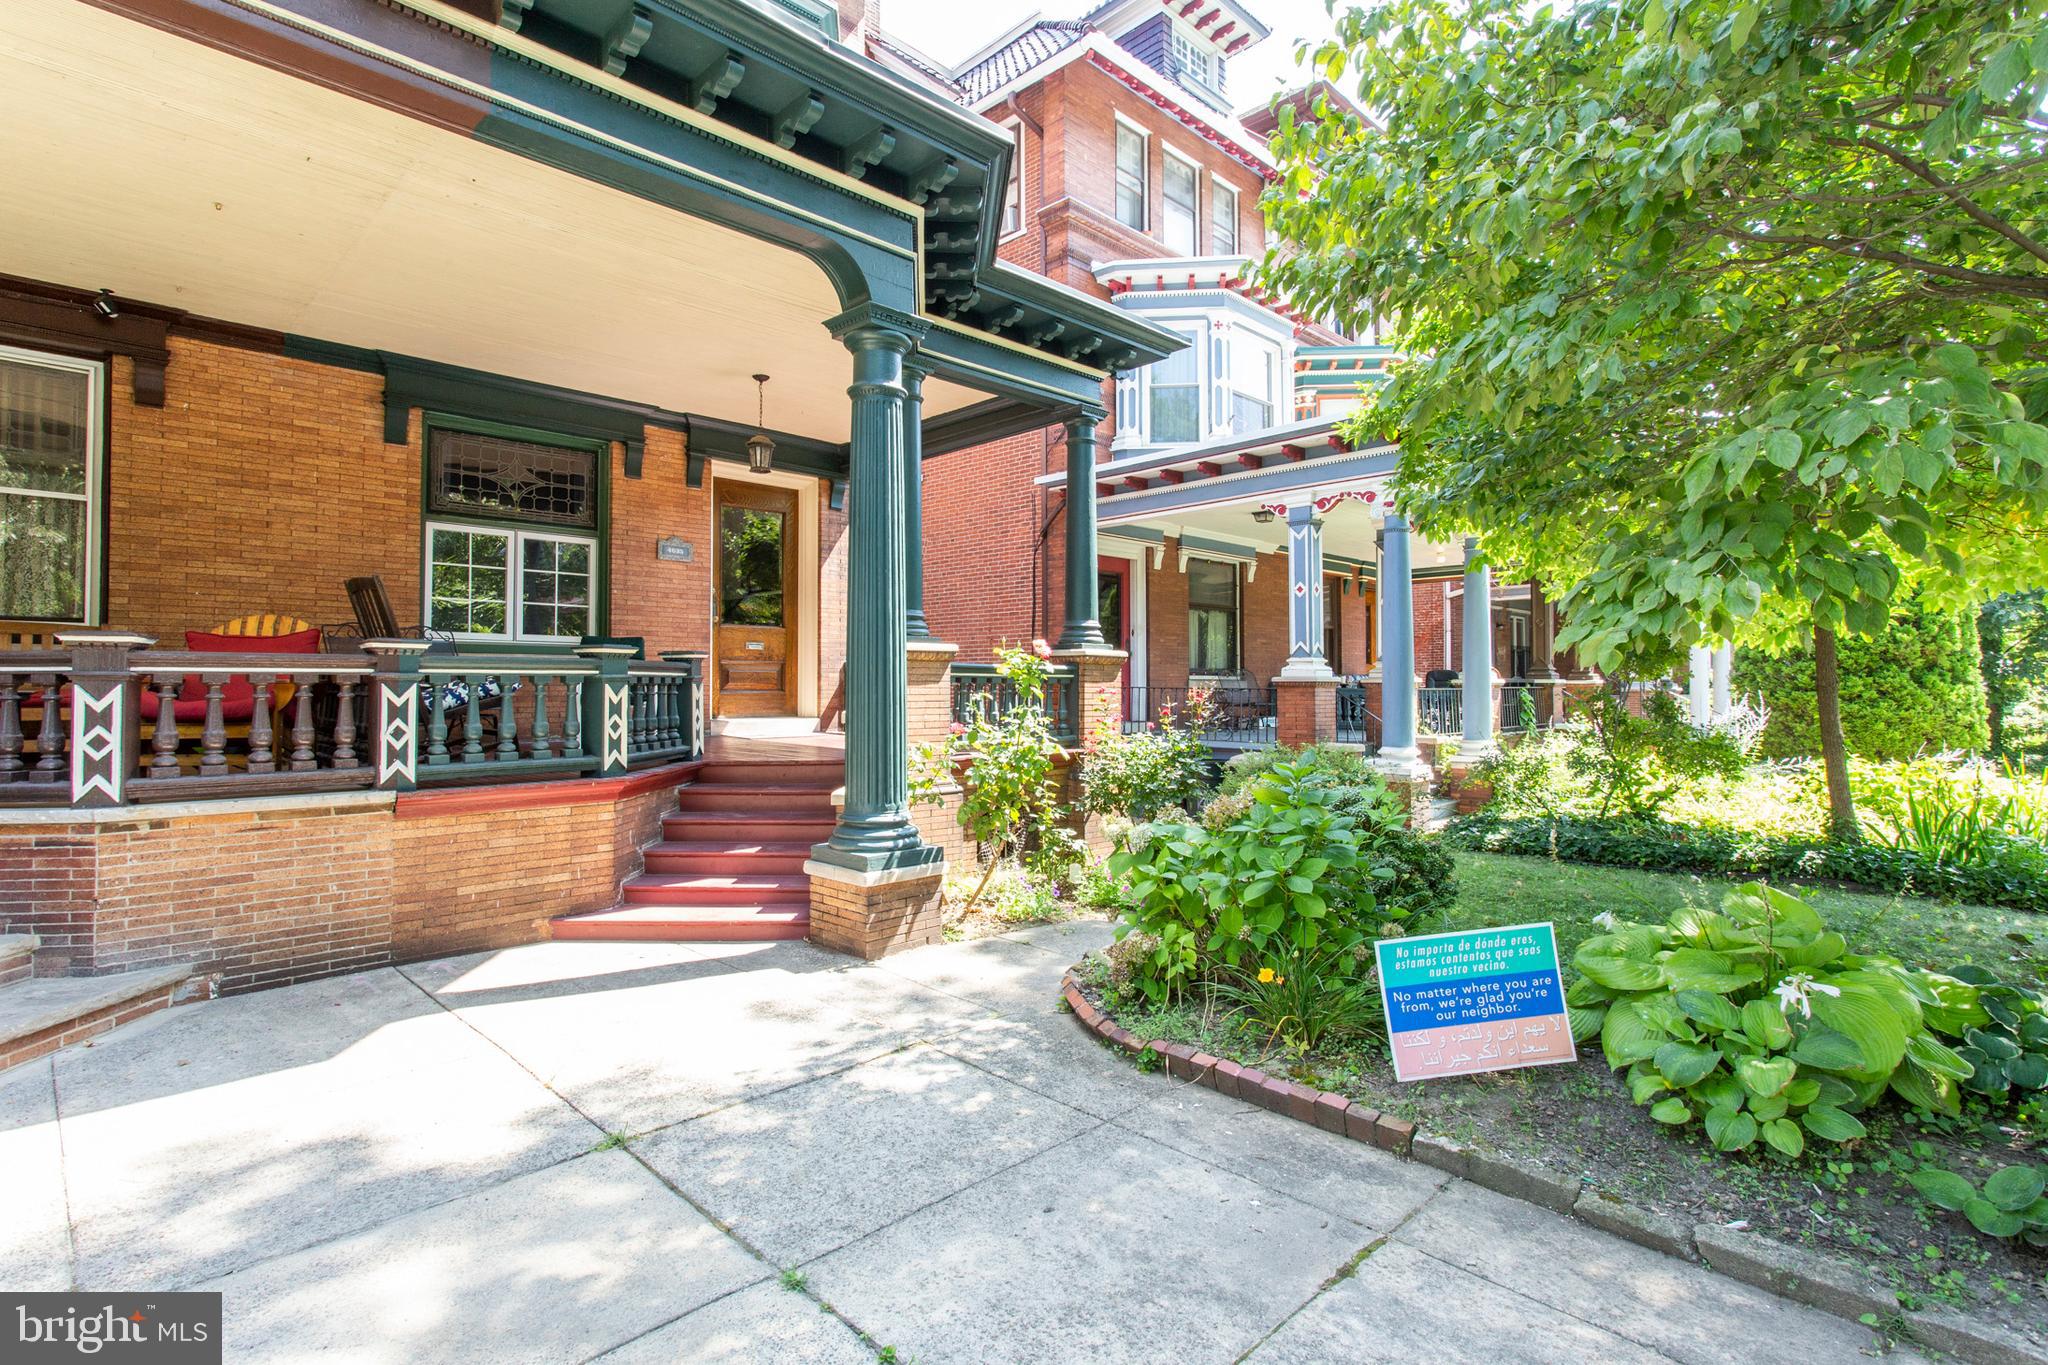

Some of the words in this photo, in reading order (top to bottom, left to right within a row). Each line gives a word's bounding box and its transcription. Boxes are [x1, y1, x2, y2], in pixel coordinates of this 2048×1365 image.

[1395, 957, 1437, 971] estamos
[1441, 951, 1491, 966] contentos
[1495, 948, 1514, 961] que
[1518, 944, 1541, 956] seas
[1396, 946, 1410, 958] No
[1413, 944, 1454, 957] importa
[1458, 938, 1471, 951] de
[1475, 935, 1507, 950] dónde
[1510, 934, 1537, 946] eres,
[1429, 964, 1468, 978] nuestro
[1472, 959, 1510, 973] vecino.
[1393, 991, 1411, 1002] No
[1415, 986, 1457, 1001] matter
[1462, 981, 1500, 995] where
[1504, 979, 1528, 993] you
[1532, 976, 1552, 986] are
[1401, 1001, 1434, 1014] from,
[1477, 991, 1505, 1007] glad
[1436, 1011, 1457, 1022] our
[1461, 1003, 1521, 1020] neighbor.
[1548, 1015, 1561, 1031] لا
